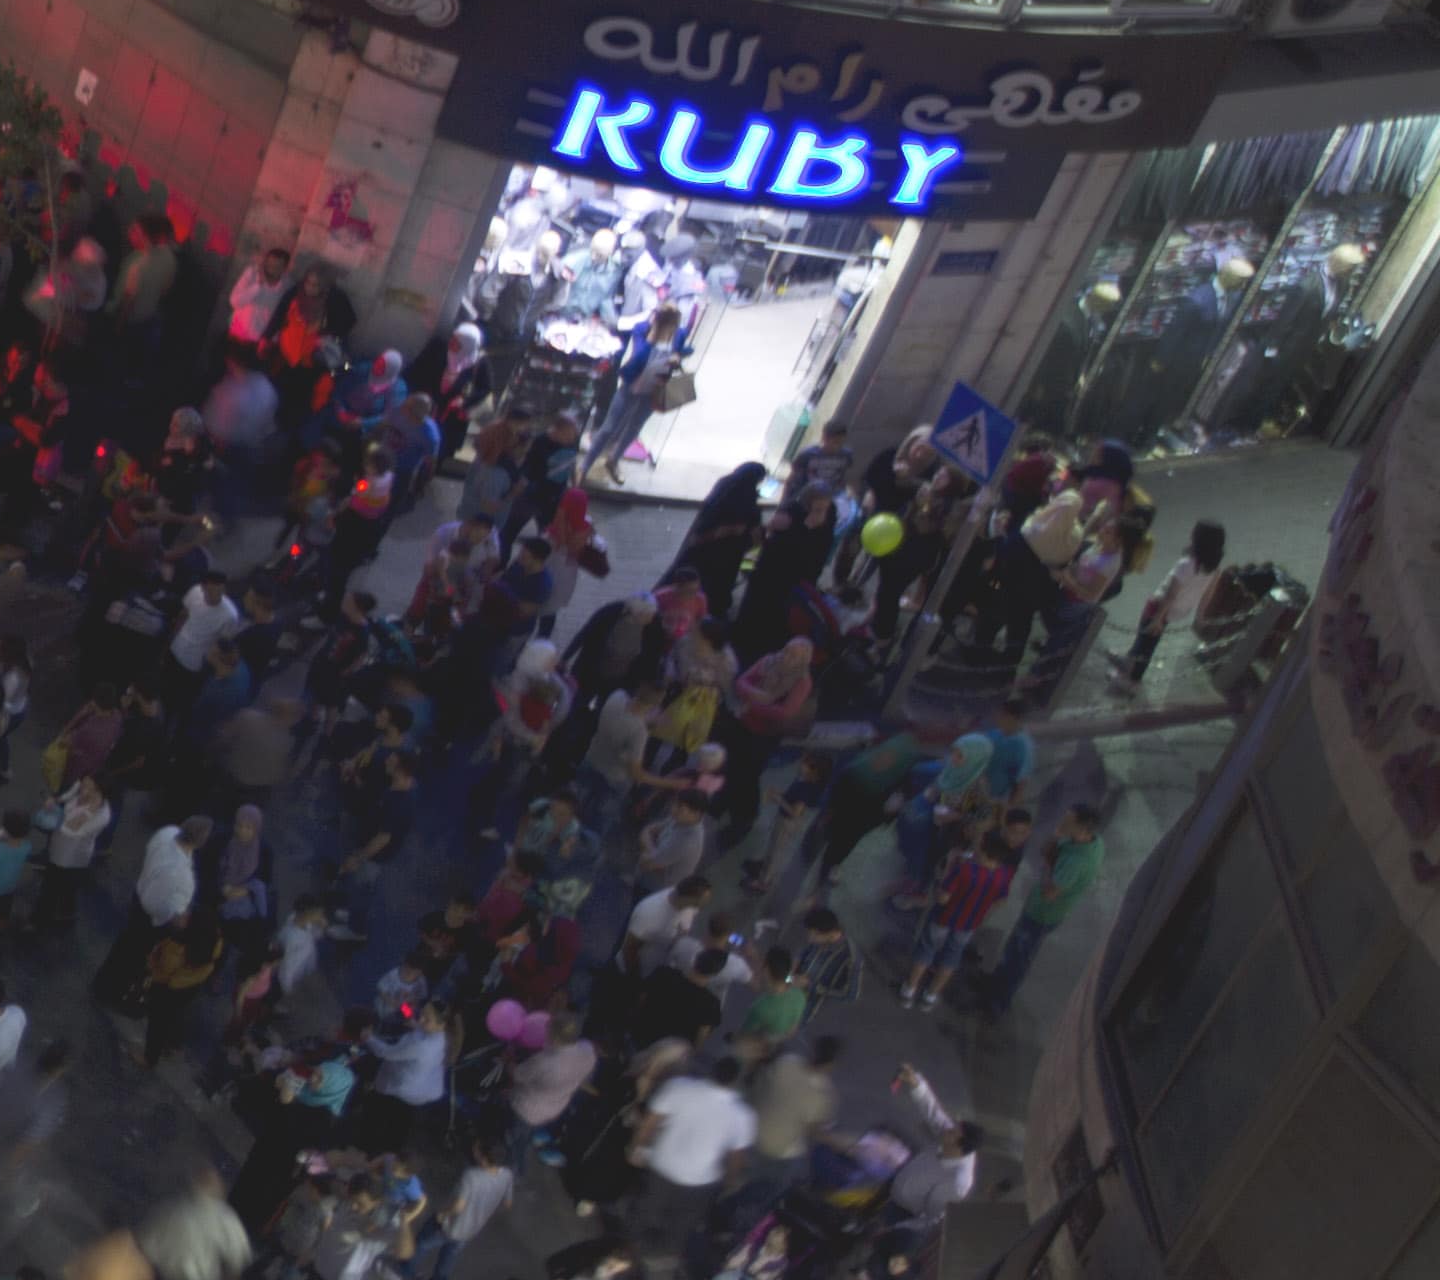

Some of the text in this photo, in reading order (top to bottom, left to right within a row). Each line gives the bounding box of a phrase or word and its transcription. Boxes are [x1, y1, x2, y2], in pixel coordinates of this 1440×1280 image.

[583, 17, 1141, 135] مقهى رام الله
